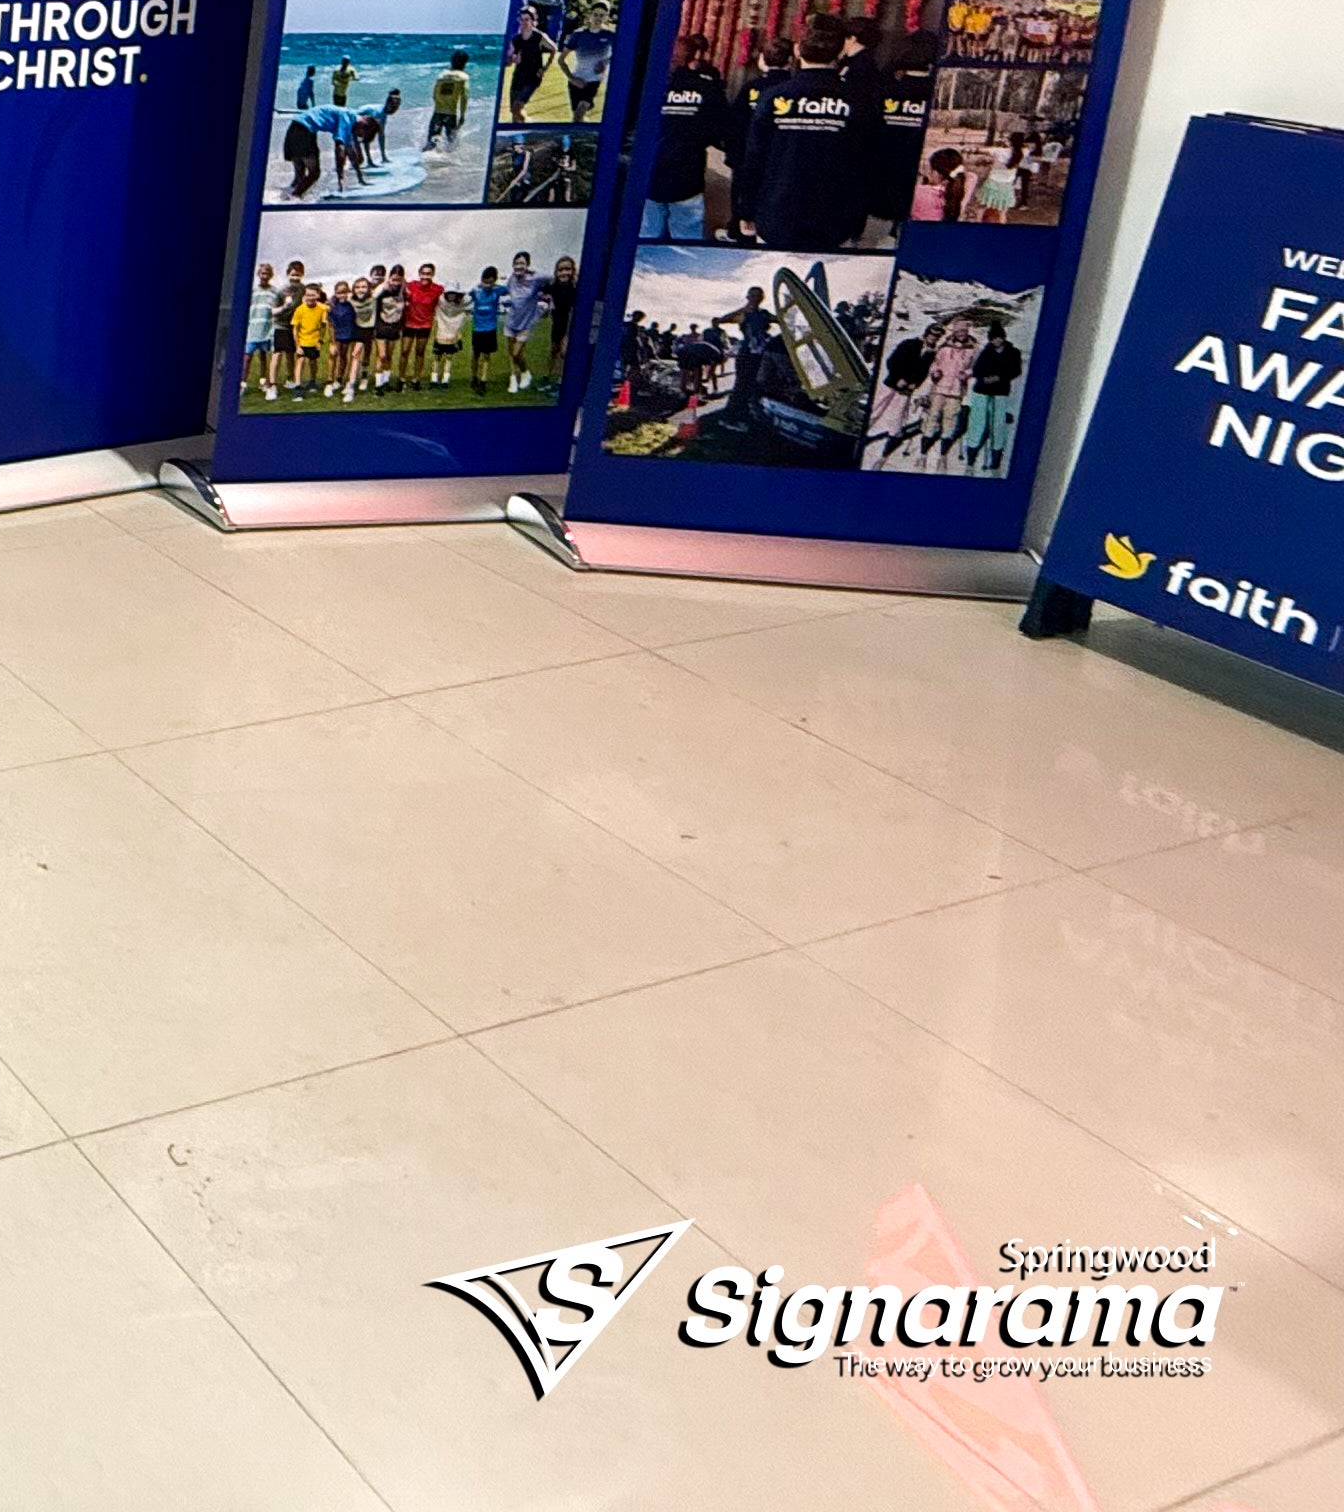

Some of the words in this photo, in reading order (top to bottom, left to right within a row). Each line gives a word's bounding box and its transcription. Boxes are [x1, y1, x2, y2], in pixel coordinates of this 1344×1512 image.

[667, 90, 703, 104] faith
[797, 96, 850, 117] faith
[1165, 561, 1319, 645] faith
